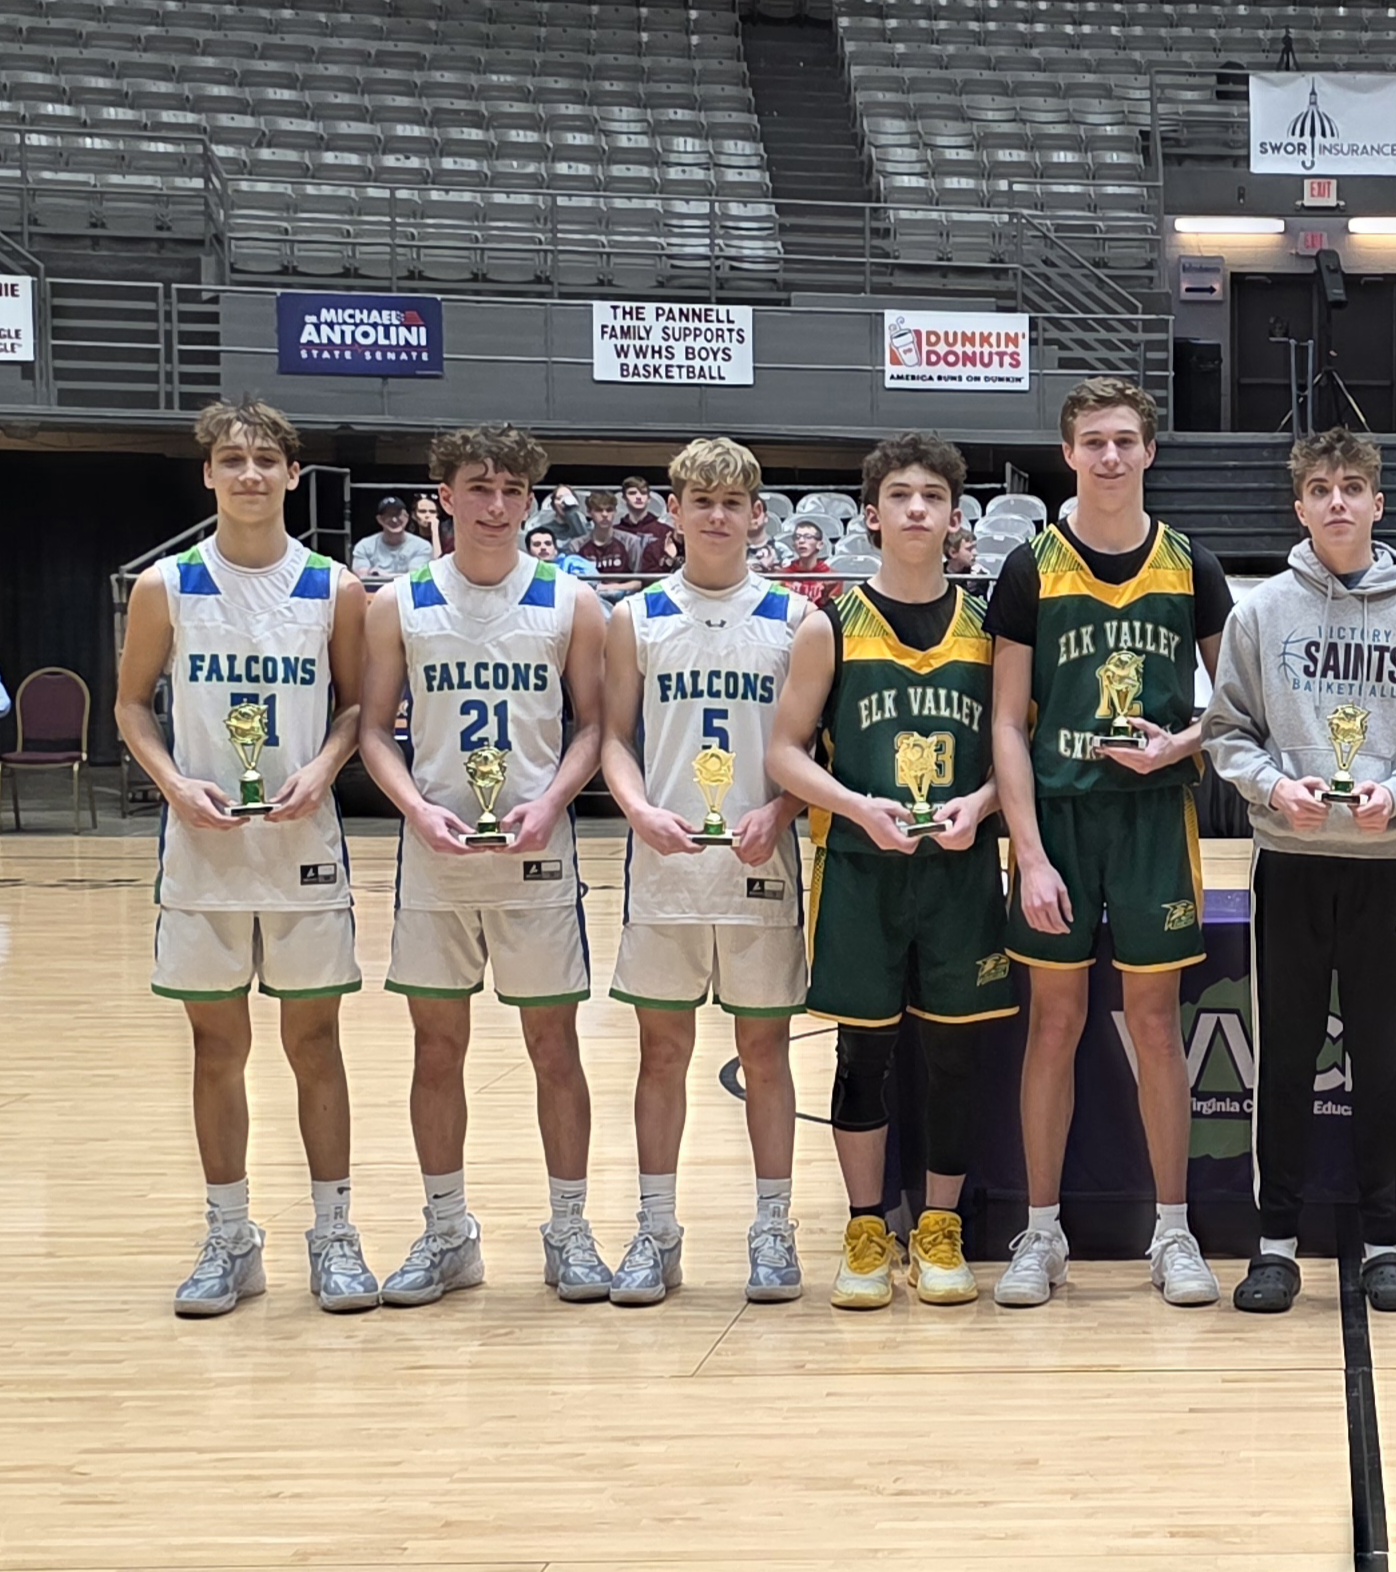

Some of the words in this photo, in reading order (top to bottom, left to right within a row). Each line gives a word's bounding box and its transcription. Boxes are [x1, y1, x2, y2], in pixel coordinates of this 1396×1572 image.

[1259, 141, 1307, 155] SWOR
[1310, 181, 1331, 198] EXIT
[320, 308, 401, 325] MICHAEL
[610, 305, 646, 321] THE
[655, 307, 735, 324] PANNELL
[300, 324, 427, 347] ANTOLINI
[600, 324, 652, 341] FAMILY
[661, 325, 745, 344] SUPPORTS
[925, 330, 1026, 349] DUNKIN'
[300, 349, 352, 360] STATE
[364, 351, 429, 361] SENATE
[614, 344, 675, 360] WWHS
[685, 346, 732, 362] BOYS
[925, 349, 1021, 369] DONUTS
[620, 363, 726, 381] BASKETBALL
[889, 374, 934, 382] AMERICA
[937, 374, 963, 382] RUNS
[1057, 624, 1095, 667] ELK
[1104, 619, 1181, 663] VALLEY
[188, 653, 316, 685] FALCONS
[423, 661, 548, 693] FALCONS
[657, 669, 774, 704] FALCONS
[858, 689, 898, 731] ELK
[907, 686, 983, 732] VALLEY
[460, 699, 512, 752] 21
[702, 707, 730, 753] 5
[1192, 1098, 1240, 1115] irginia
